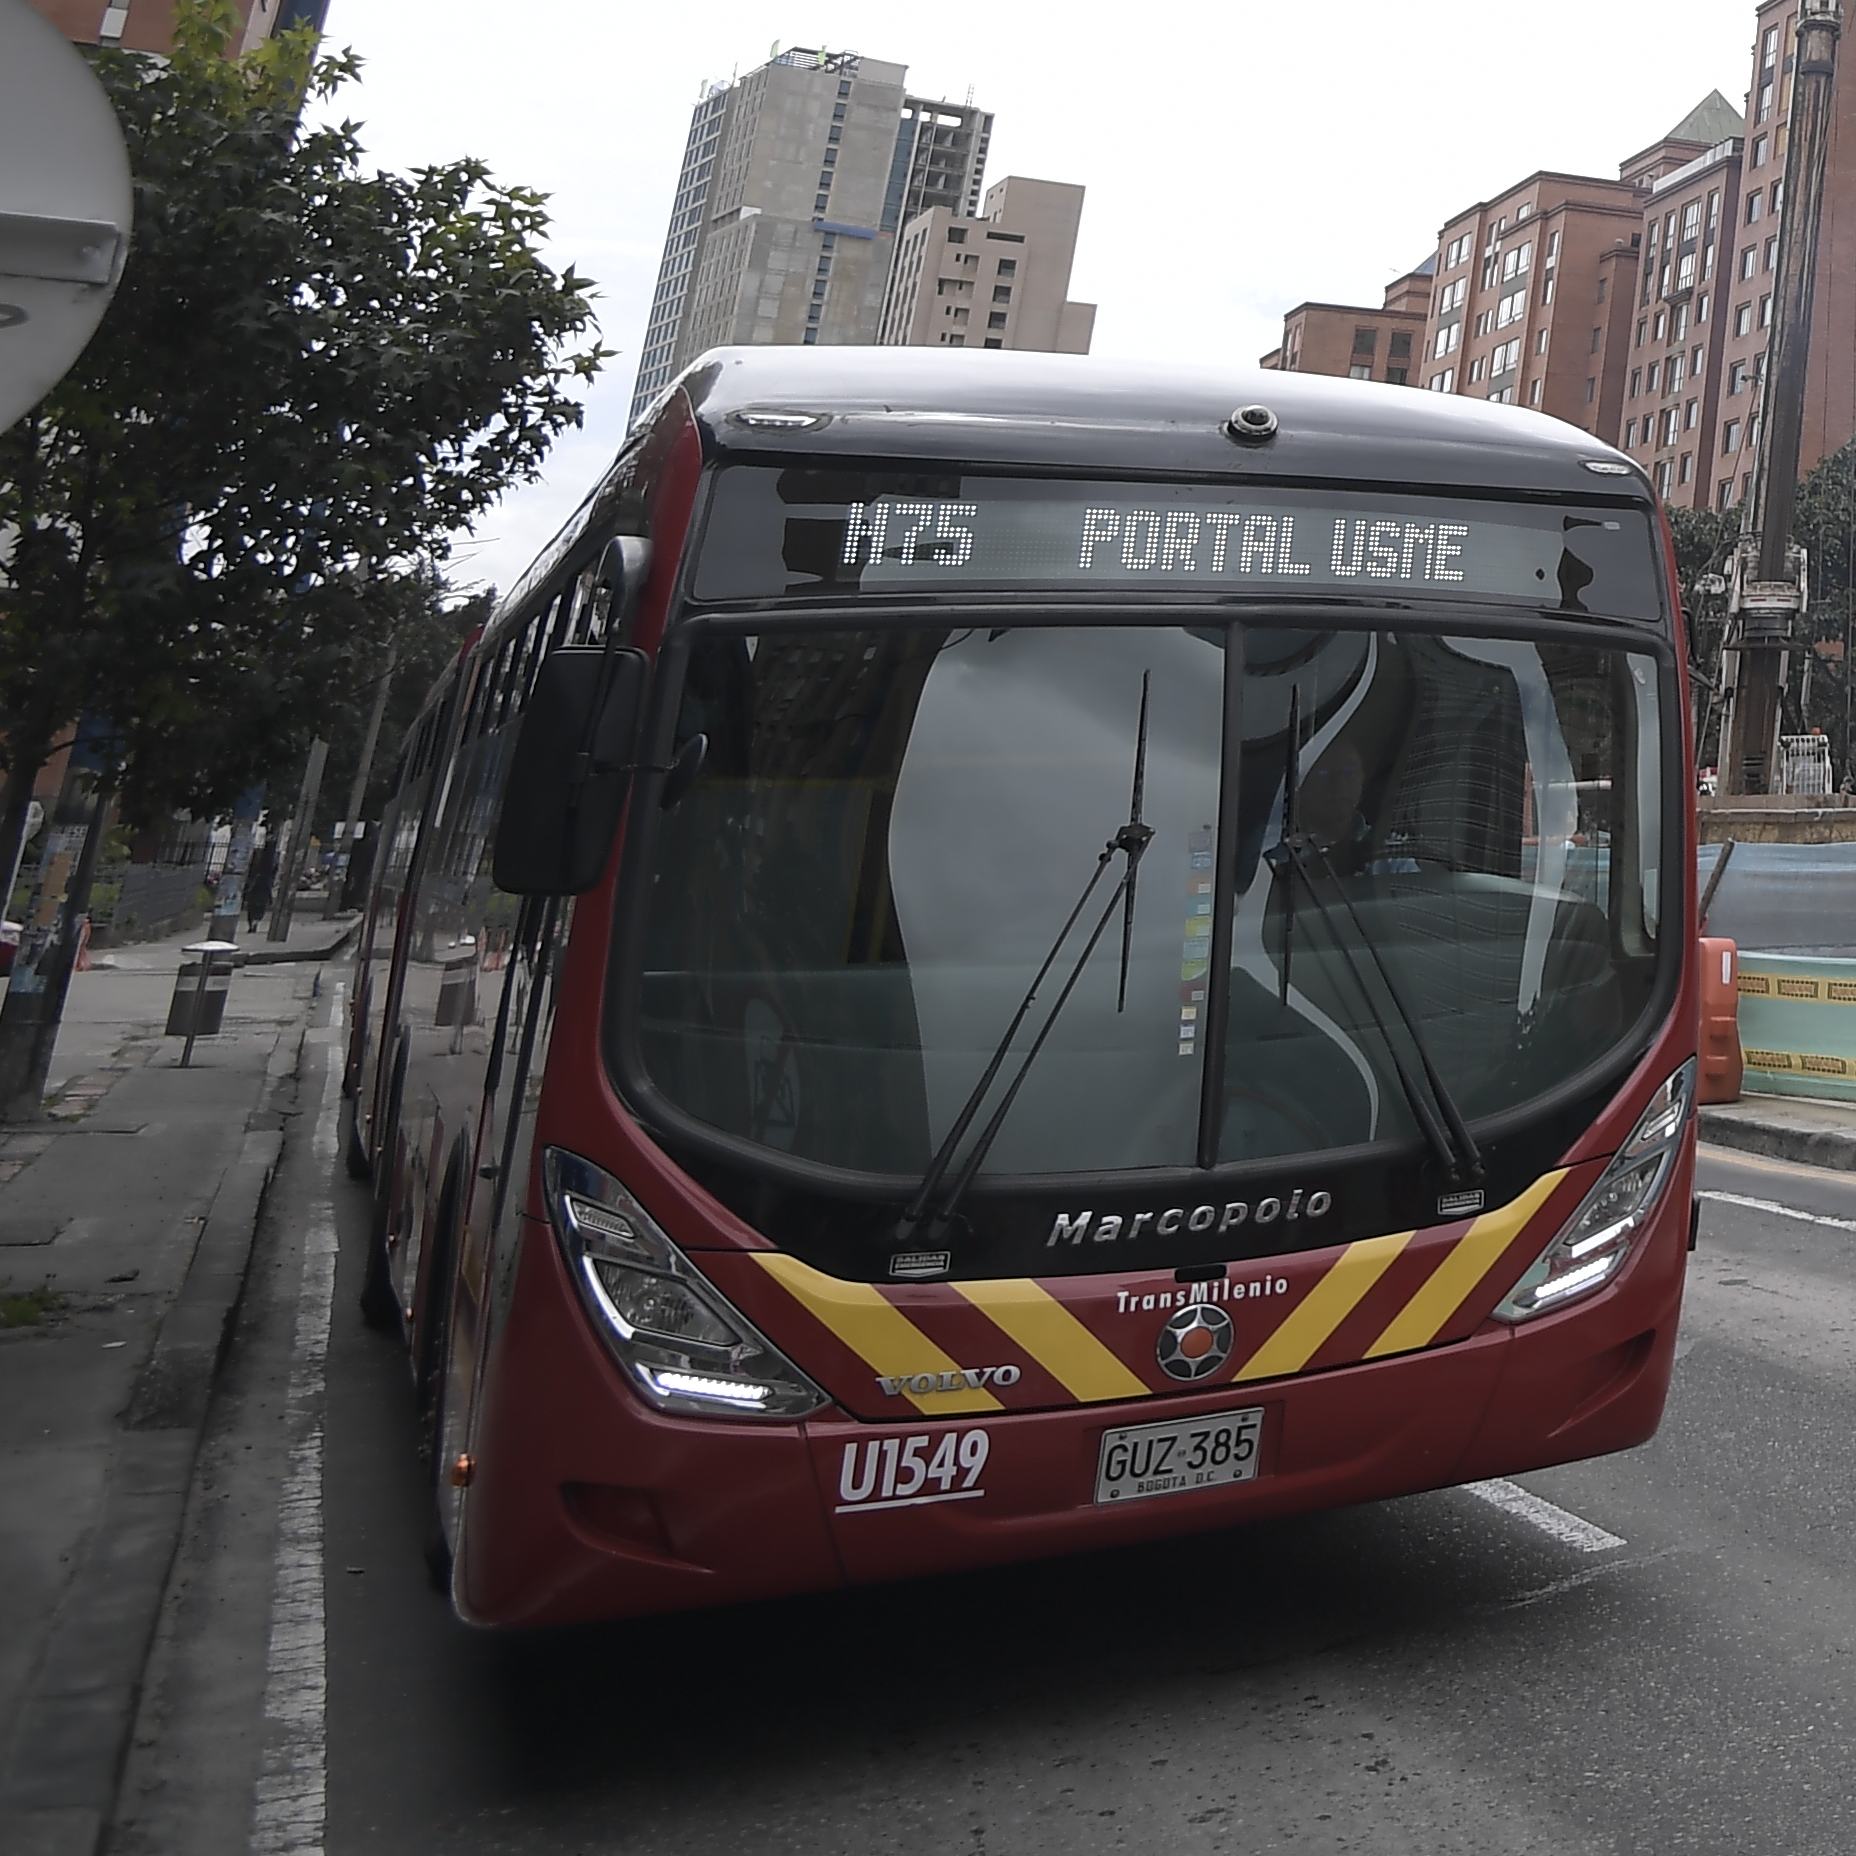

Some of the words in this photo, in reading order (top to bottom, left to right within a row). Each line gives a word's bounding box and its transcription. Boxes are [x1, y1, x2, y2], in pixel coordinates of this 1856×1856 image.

[843, 502, 977, 565] H75
[1079, 509, 1310, 575] PORTAL
[1330, 518, 1469, 581] USME
[1047, 1189, 1332, 1247] Marcopolo
[1117, 1275, 1289, 1314] TransMilenio
[875, 1365, 1022, 1396] VOLVO
[839, 1429, 990, 1501] U1549
[1137, 1476, 1186, 1492] BOGOTA
